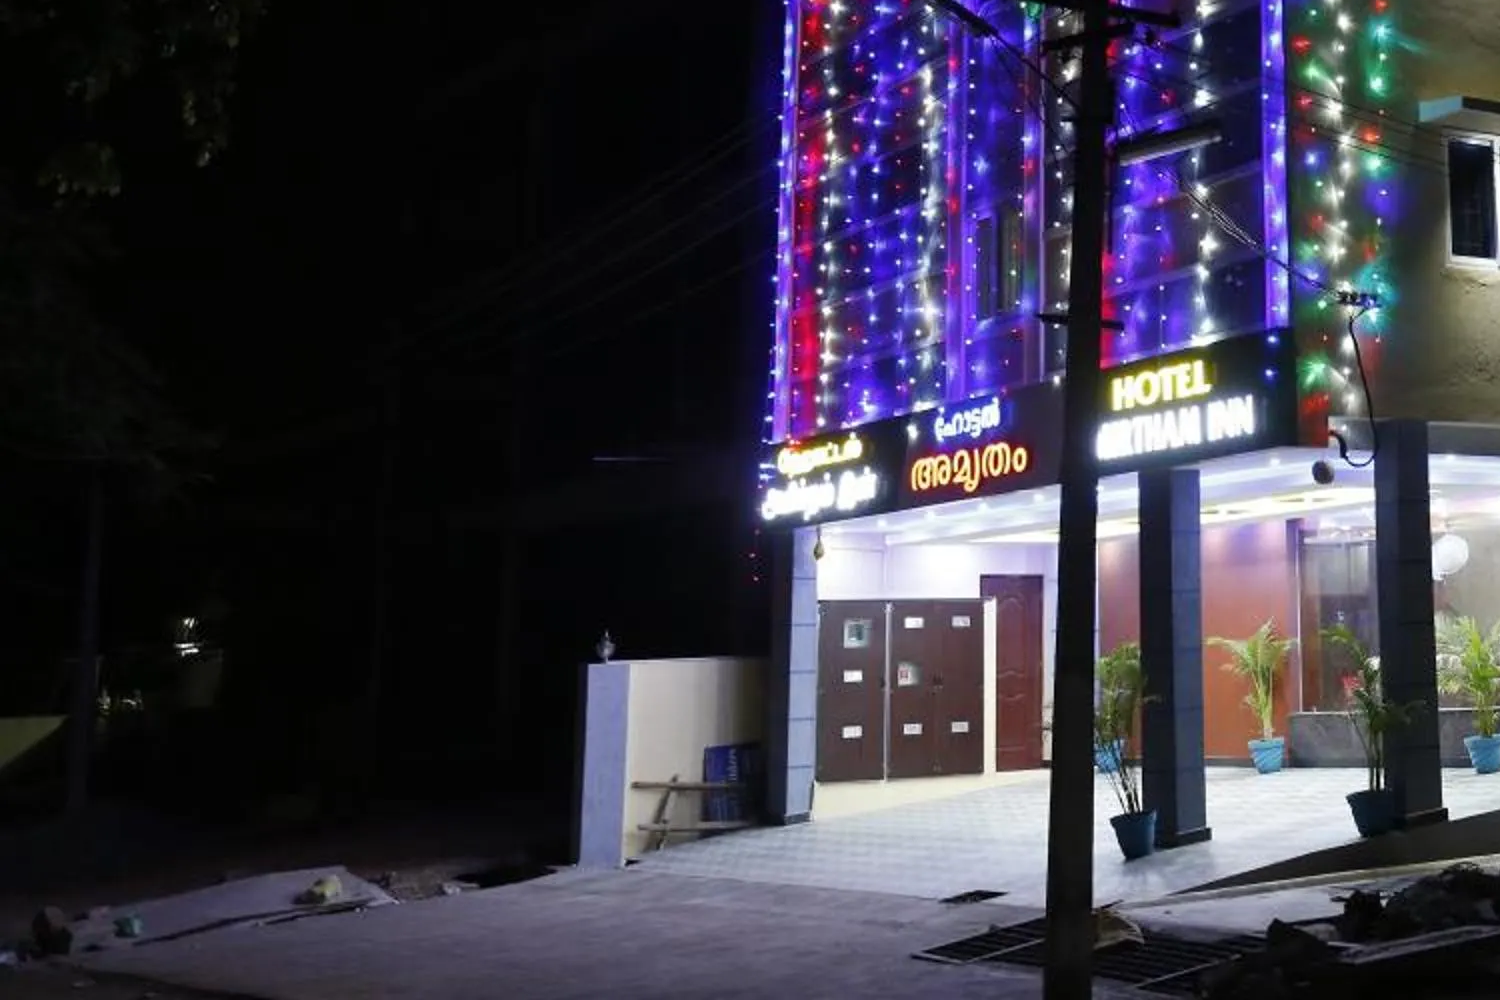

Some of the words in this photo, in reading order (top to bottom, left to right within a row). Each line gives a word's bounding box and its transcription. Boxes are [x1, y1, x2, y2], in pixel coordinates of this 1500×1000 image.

[1111, 359, 1213, 411] HOTEL
[1206, 394, 1254, 442] INN
[911, 442, 1028, 492] അമൃതം
